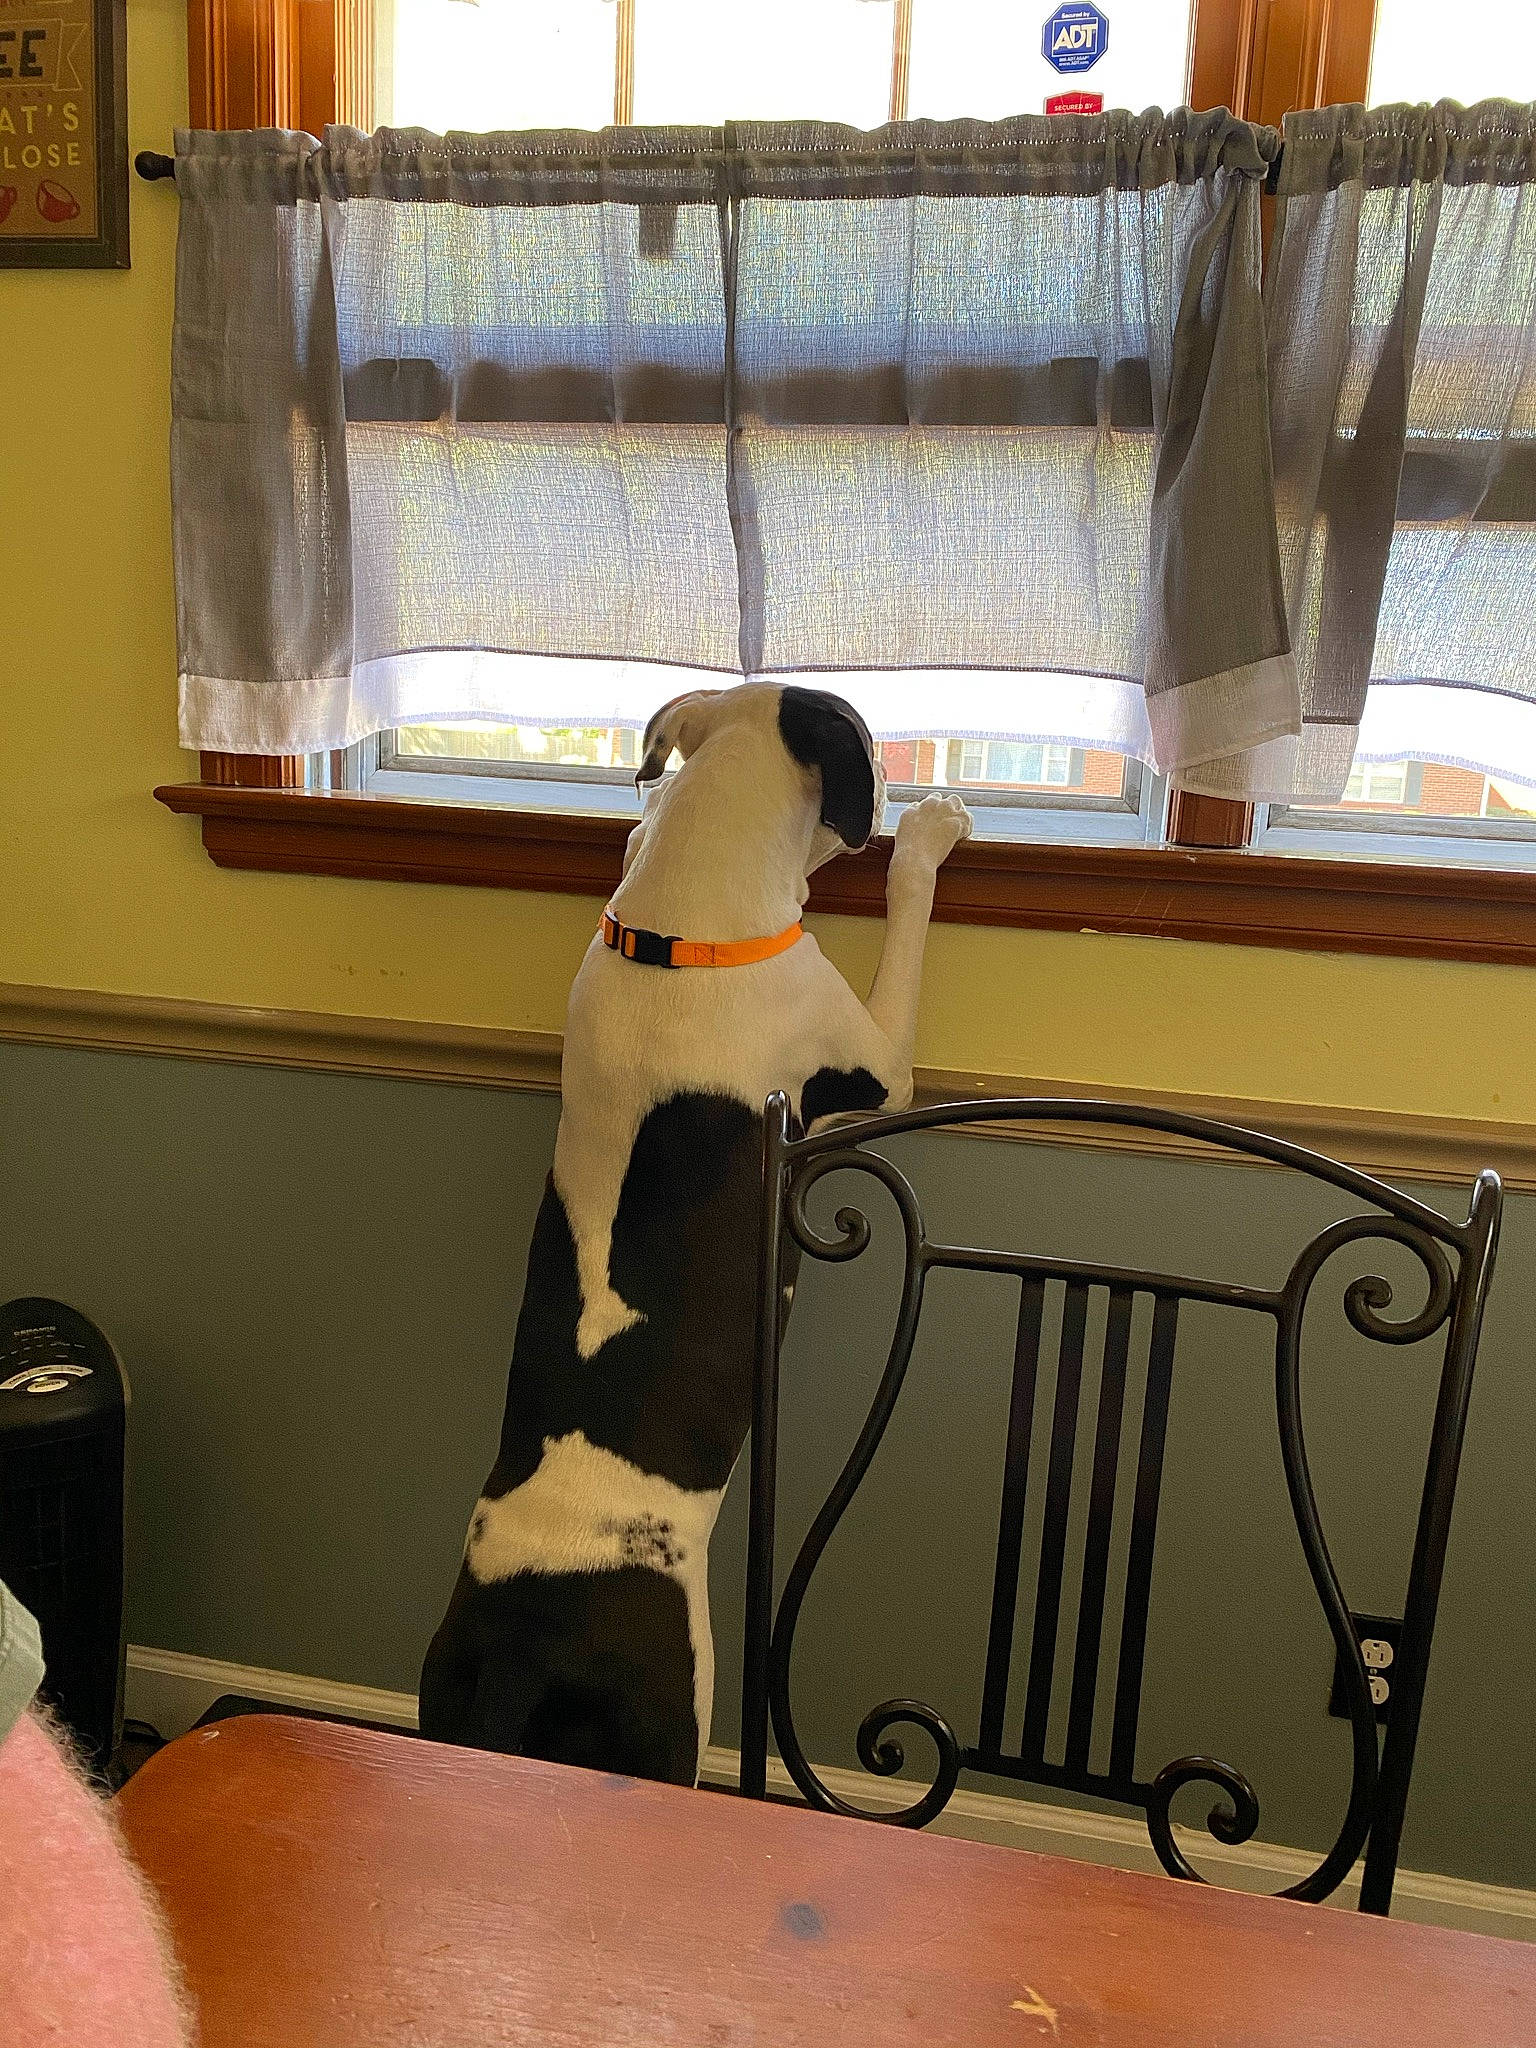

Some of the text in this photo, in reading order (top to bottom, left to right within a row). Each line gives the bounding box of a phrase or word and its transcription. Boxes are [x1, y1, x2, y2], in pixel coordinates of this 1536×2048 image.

[1053, 24, 1098, 51] ADT
[1054, 103, 1083, 111] SECURED
[4, 142, 81, 169] LOSE
